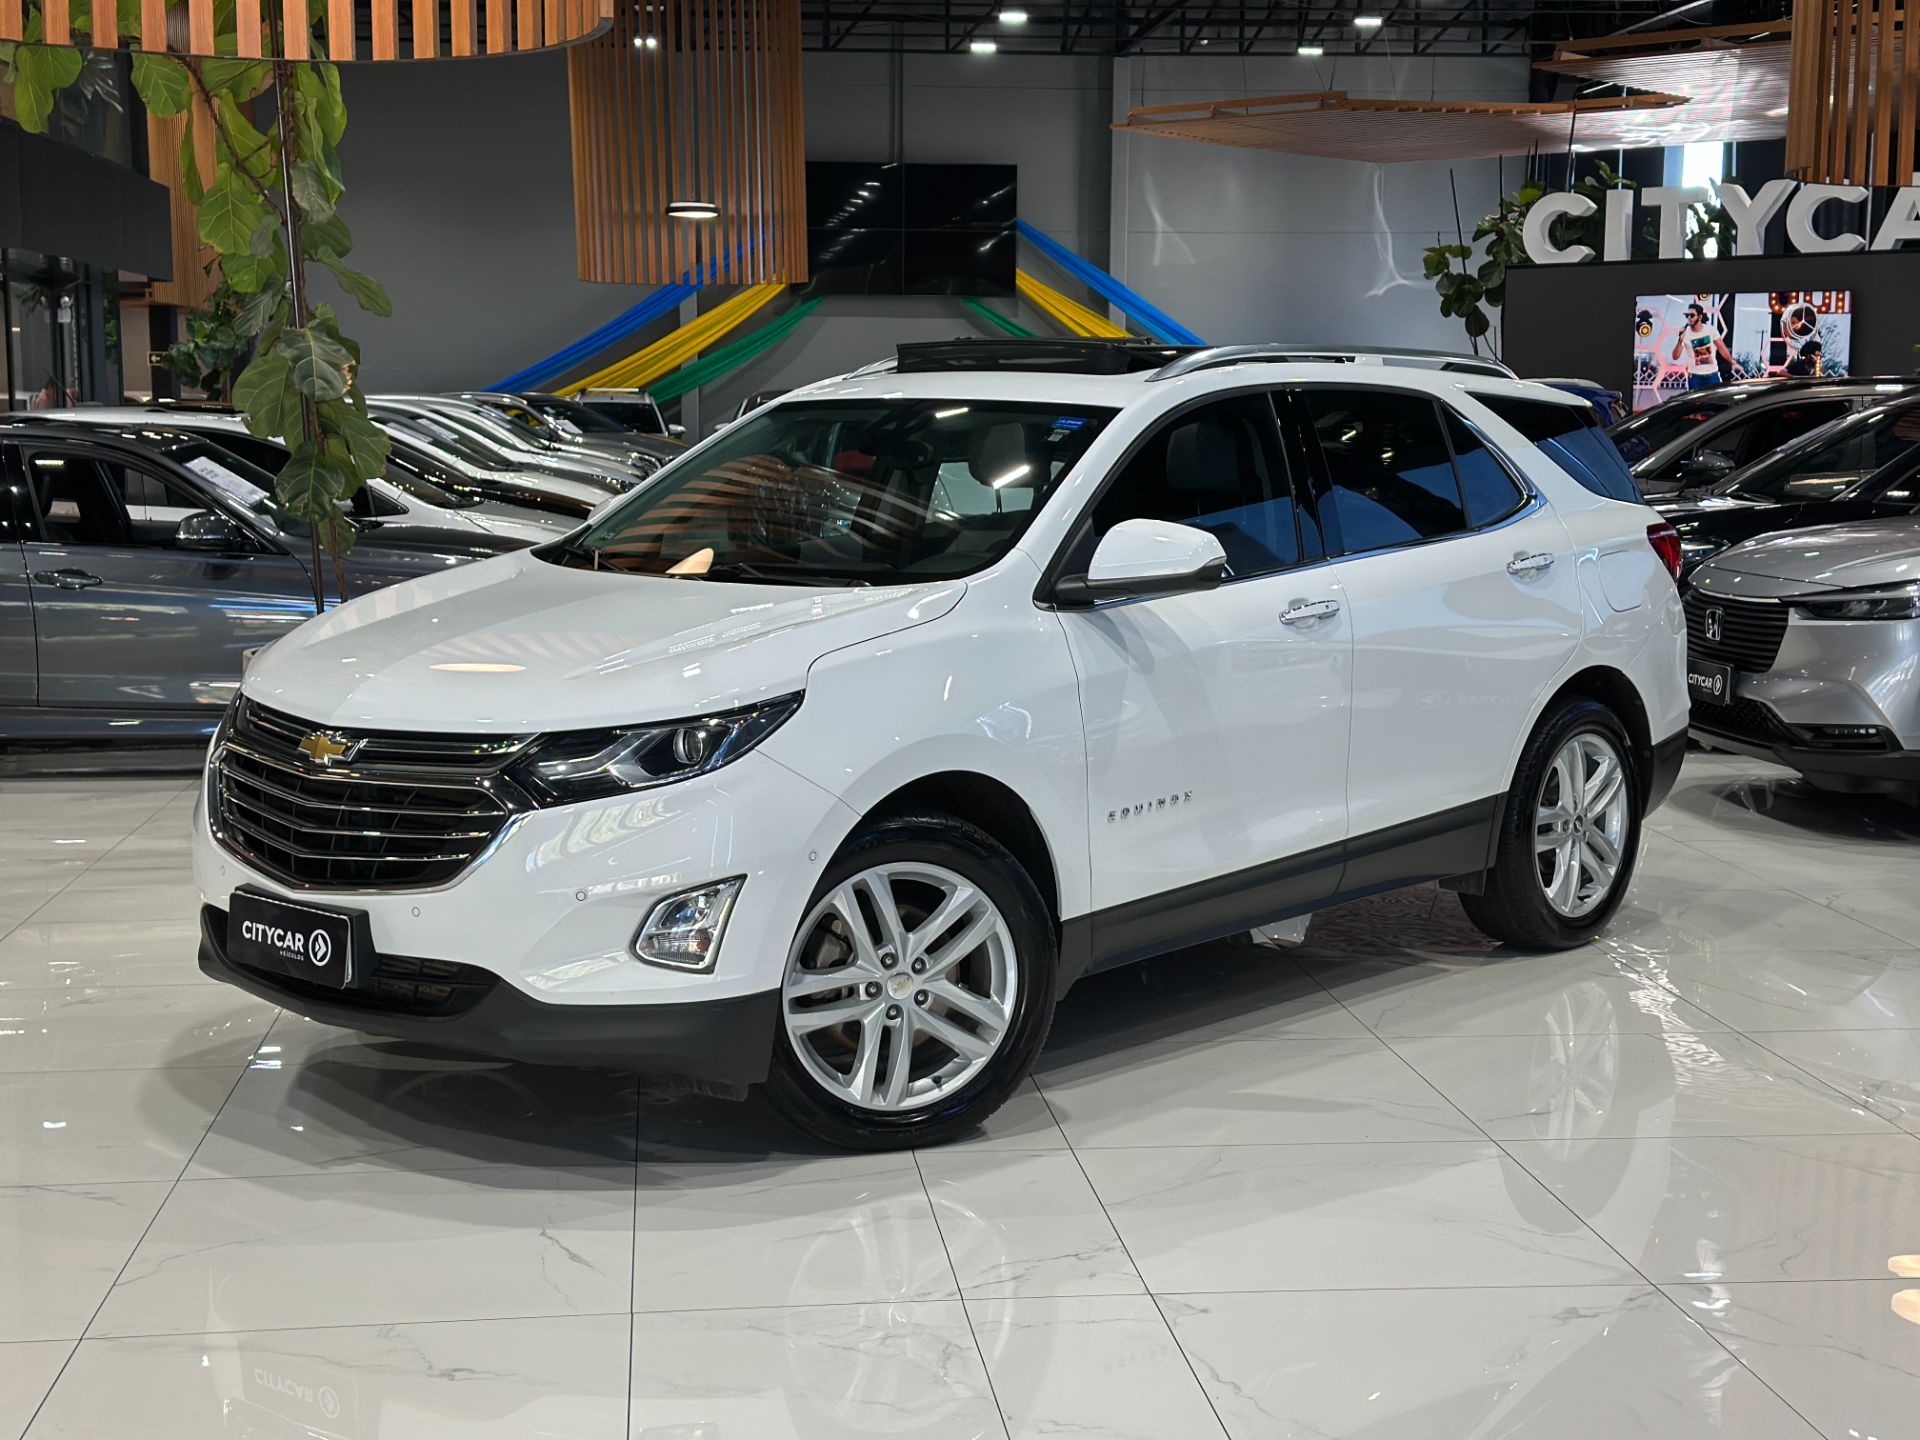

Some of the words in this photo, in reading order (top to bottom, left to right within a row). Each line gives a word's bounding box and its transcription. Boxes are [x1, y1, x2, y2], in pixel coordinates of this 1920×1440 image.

[1688, 673, 1713, 689] CITYCAR
[1107, 791, 1192, 823] EQUINOX
[242, 920, 304, 953] CITYCAR
